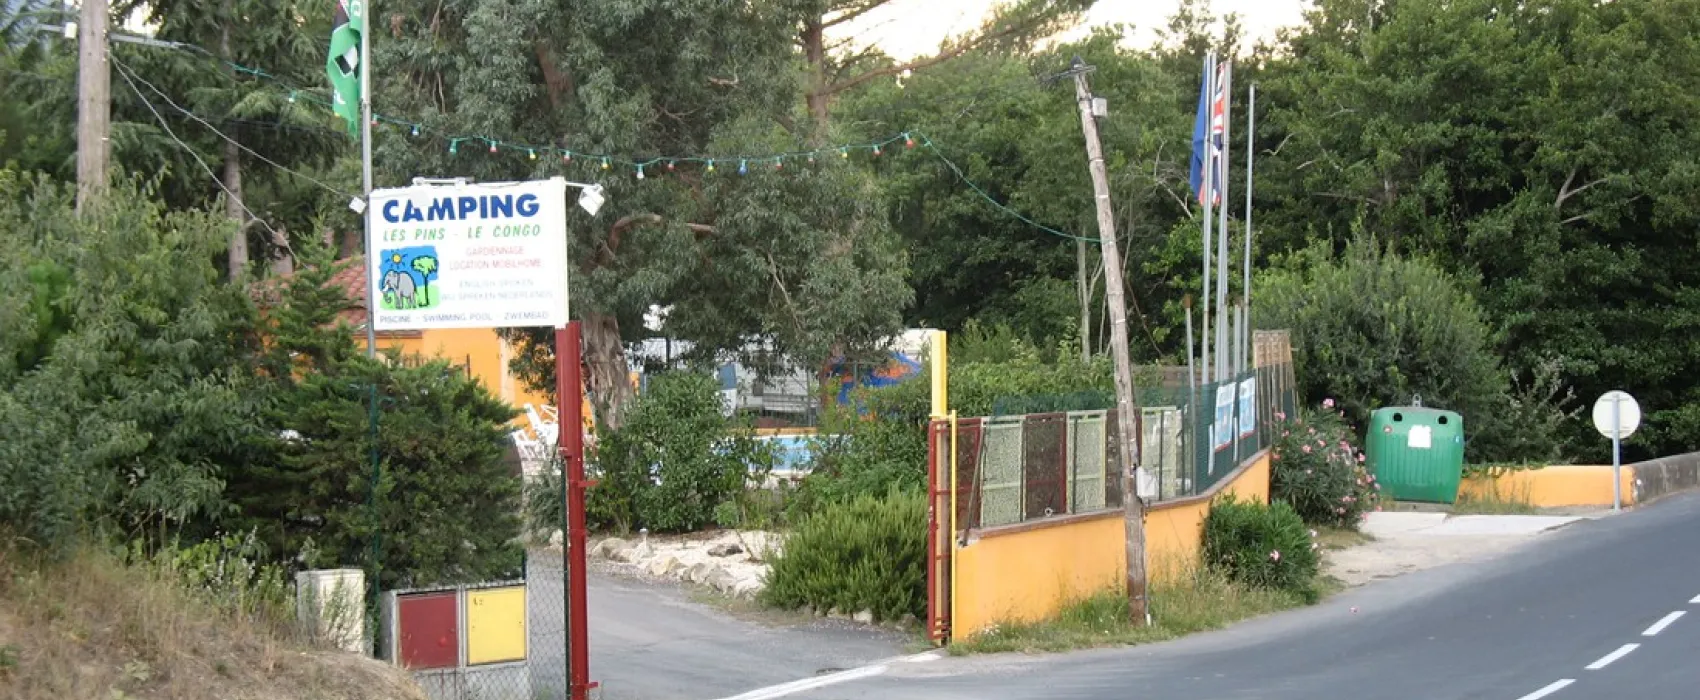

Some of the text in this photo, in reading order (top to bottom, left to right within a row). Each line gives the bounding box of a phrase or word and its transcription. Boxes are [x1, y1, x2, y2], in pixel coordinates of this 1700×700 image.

[382, 193, 540, 223] CAMPING
[383, 228, 406, 242] LES
[415, 227, 446, 241] PINS
[467, 226, 483, 239] LE
[492, 224, 541, 238] CONGO
[449, 259, 489, 271] LOCATION
[380, 315, 411, 324] PISCINE
[423, 313, 466, 323] SWIMMING
[470, 312, 493, 321] POOL
